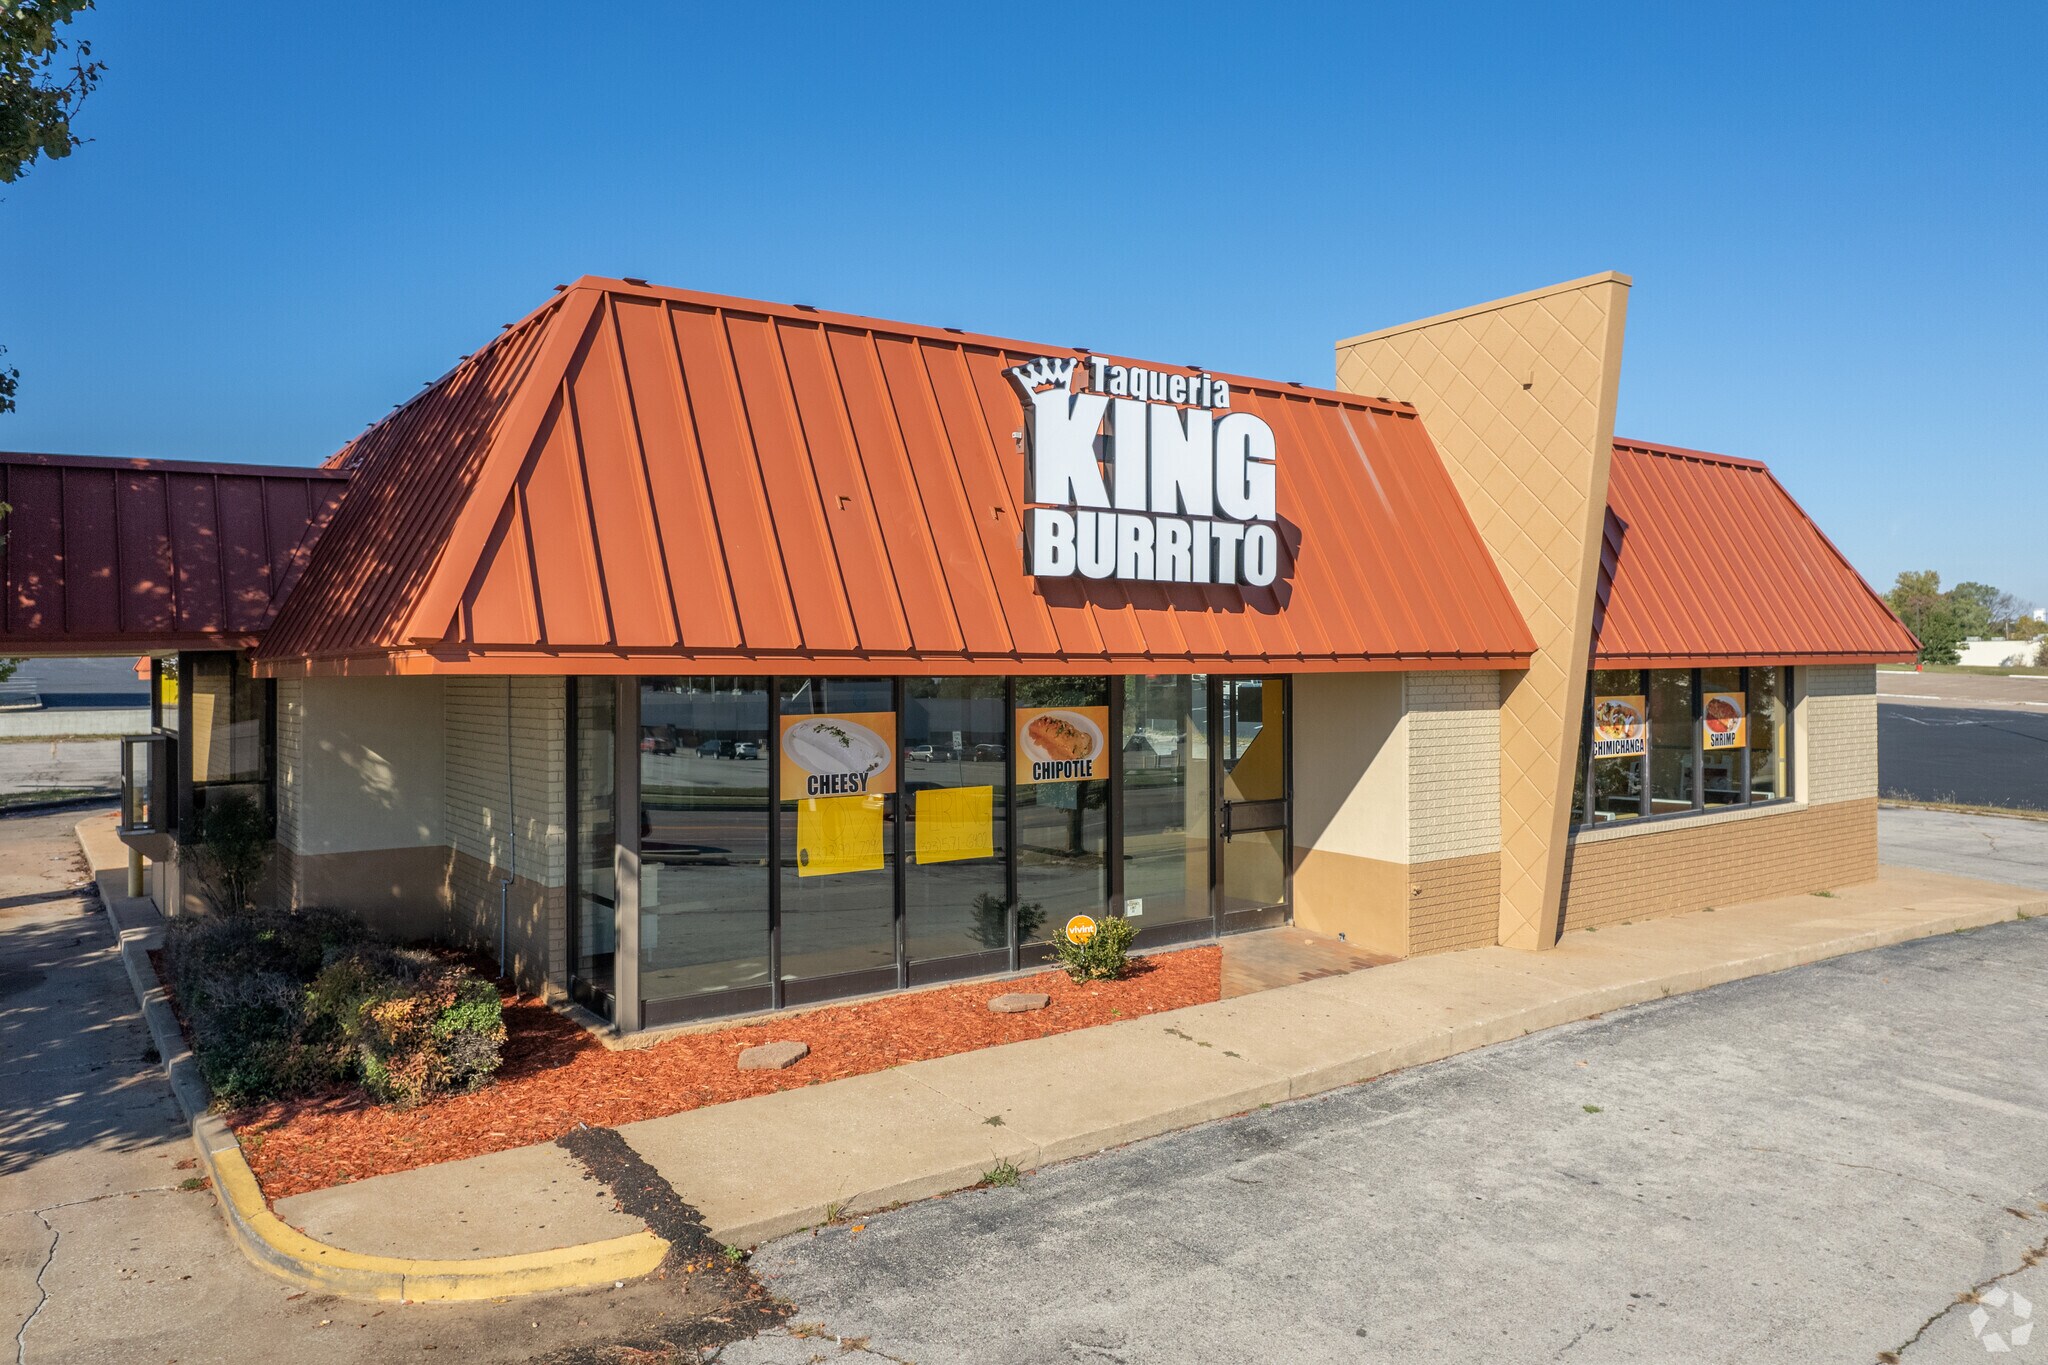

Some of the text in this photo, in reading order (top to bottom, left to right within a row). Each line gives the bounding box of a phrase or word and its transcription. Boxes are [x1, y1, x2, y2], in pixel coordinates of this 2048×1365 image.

[1090, 355, 1230, 409] Taqueria
[1034, 391, 1276, 522] KING
[1033, 507, 1277, 587] BURRITO
[1593, 738, 1645, 756] CHIMICHANGA
[1710, 731, 1736, 747] SHRIMP
[1032, 759, 1093, 781] CHIPOTLE
[807, 772, 869, 796] CHEESY
[801, 800, 882, 842] NOW
[1069, 925, 1094, 934] vivint
